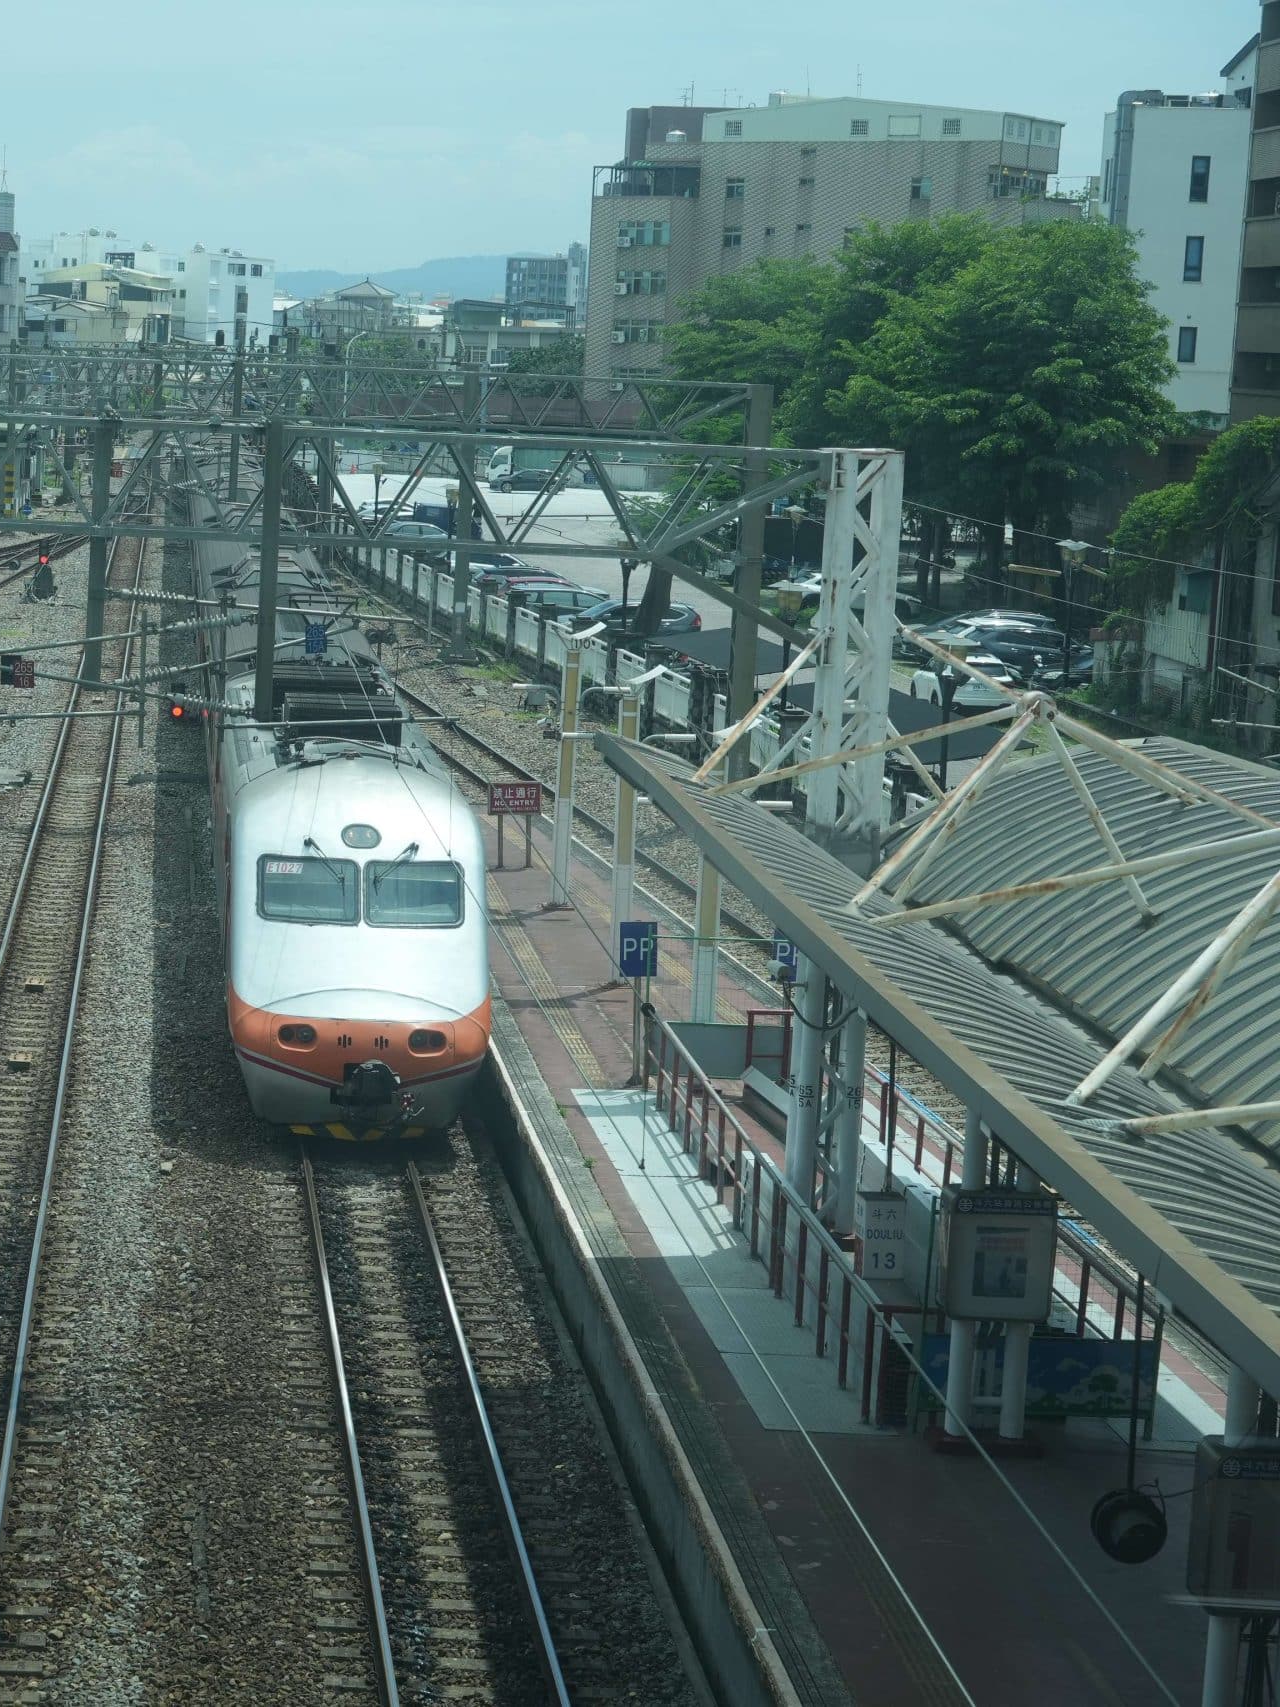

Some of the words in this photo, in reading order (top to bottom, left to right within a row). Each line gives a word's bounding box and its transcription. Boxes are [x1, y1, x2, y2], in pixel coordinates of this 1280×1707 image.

[306, 626, 325, 637] 265
[14, 662, 33, 673] 265
[20, 676, 30, 687] 16
[267, 863, 303, 873] E1027
[623, 937, 654, 961] PP
[871, 1208, 898, 1220] 斗六
[866, 1228, 904, 1240] DOULIU
[871, 1252, 896, 1270] 13
